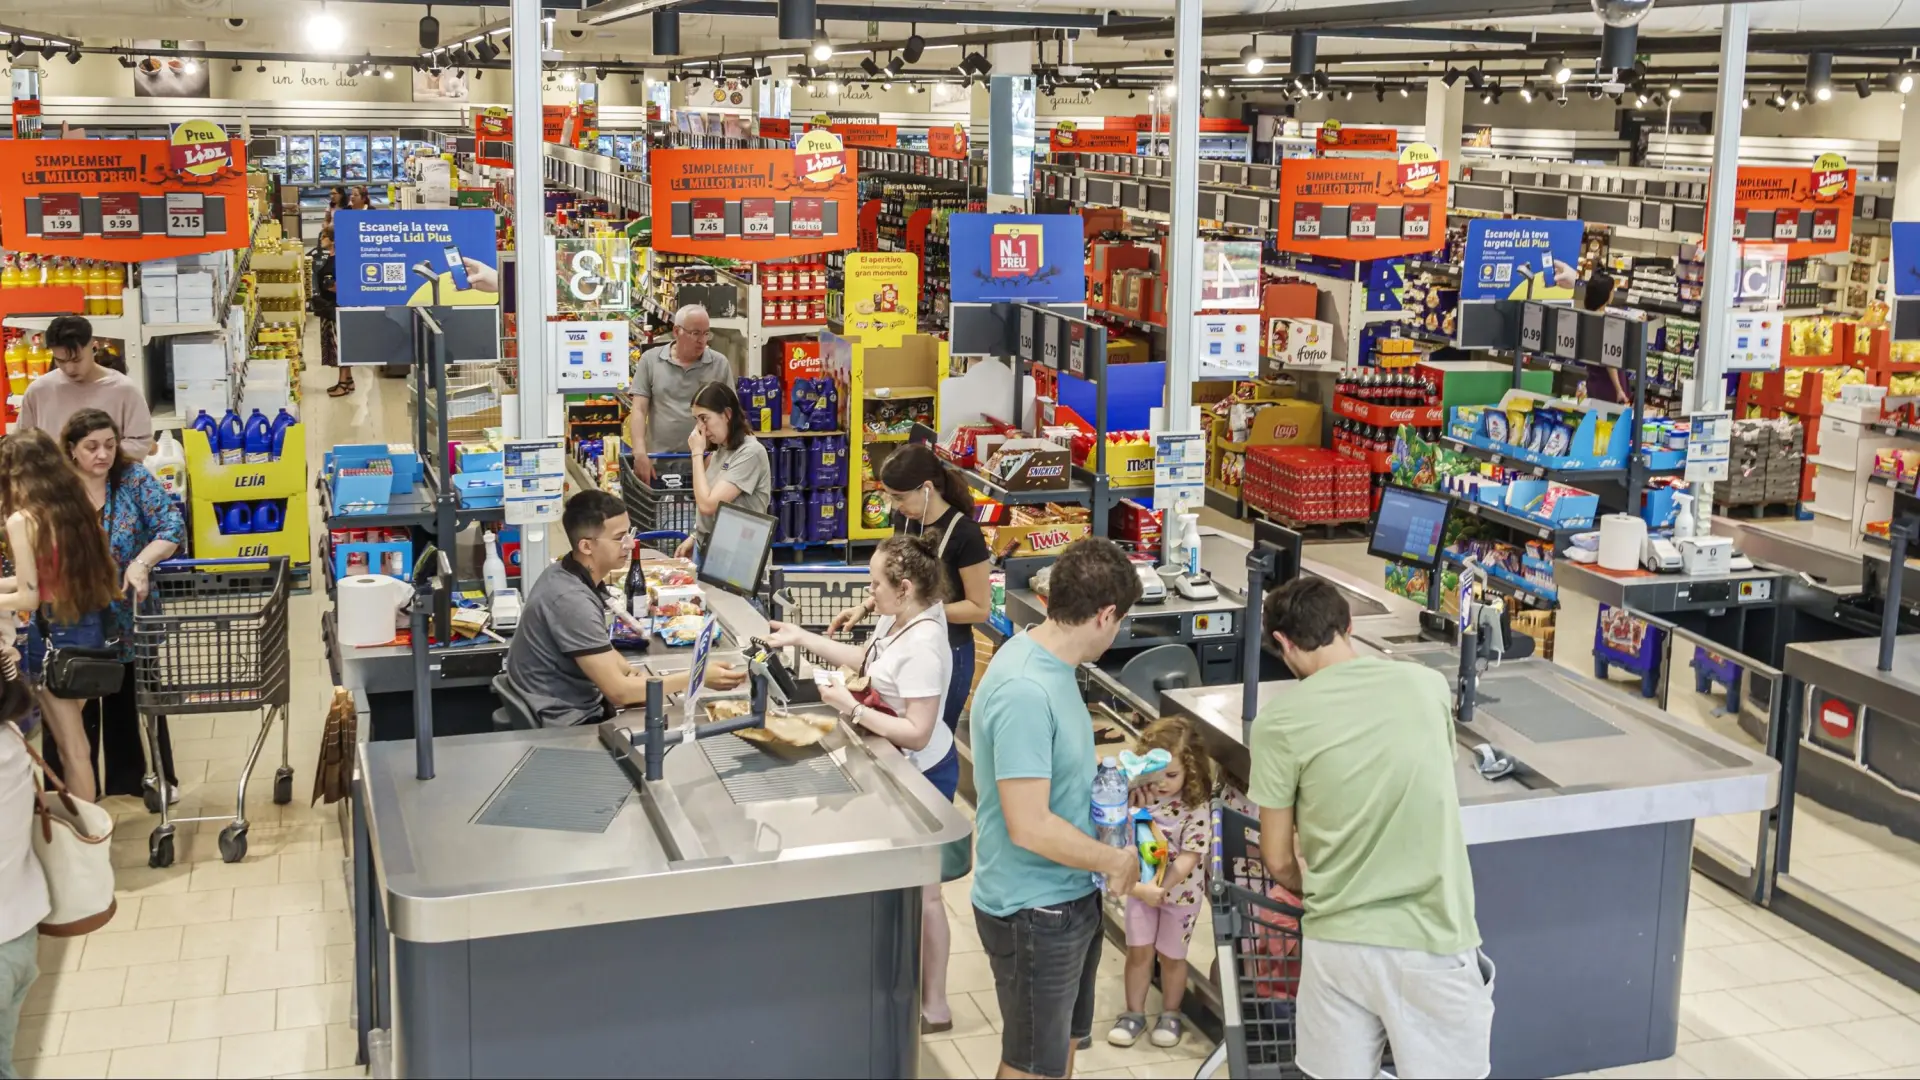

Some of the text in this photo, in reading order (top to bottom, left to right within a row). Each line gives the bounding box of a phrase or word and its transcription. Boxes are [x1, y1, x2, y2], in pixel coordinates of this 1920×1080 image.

[186, 129, 215, 142] Preu
[808, 140, 832, 151] Preu
[35, 155, 123, 167] SIMPLEMENT
[1409, 151, 1429, 161] Preu
[682, 163, 755, 175] SIMPLEMENT
[1822, 160, 1839, 169] Preu
[24, 171, 40, 183] EL
[45, 170, 97, 182] MILLOR
[101, 169, 136, 182] PREU
[1306, 171, 1365, 181] SIMPLEMENT
[673, 179, 685, 188] EL
[689, 178, 734, 189] MILLOR
[736, 177, 764, 188] PREU
[1736, 178, 1782, 187] IMPLEMENT
[1312, 184, 1346, 195] MILLOR
[1350, 183, 1373, 194] PREU
[50, 220, 73, 229] 1.99
[109, 220, 132, 229] 9.99
[172, 216, 200, 228] 2.15
[359, 221, 449, 234] Escaneja la teva
[699, 223, 718, 231] 7.45
[749, 223, 769, 231] 0.74
[359, 232, 452, 245] targeta Lidl Plus
[1485, 229, 1549, 240] Escaneja la teva
[1483, 240, 1513, 249] targeta
[868, 256, 904, 264] aperitivo,
[1000, 257, 1027, 268] PREU
[855, 270, 872, 278] gran
[1523, 327, 1541, 342] 0.99
[1020, 335, 1032, 349] 1.30
[1557, 335, 1575, 348] 1.09
[1603, 343, 1622, 358] 1.09
[789, 356, 820, 370] Grefus
[1028, 466, 1063, 477] SNICKERS
[234, 472, 266, 488] LEJÍA
[238, 542, 269, 557] LEJÍA
